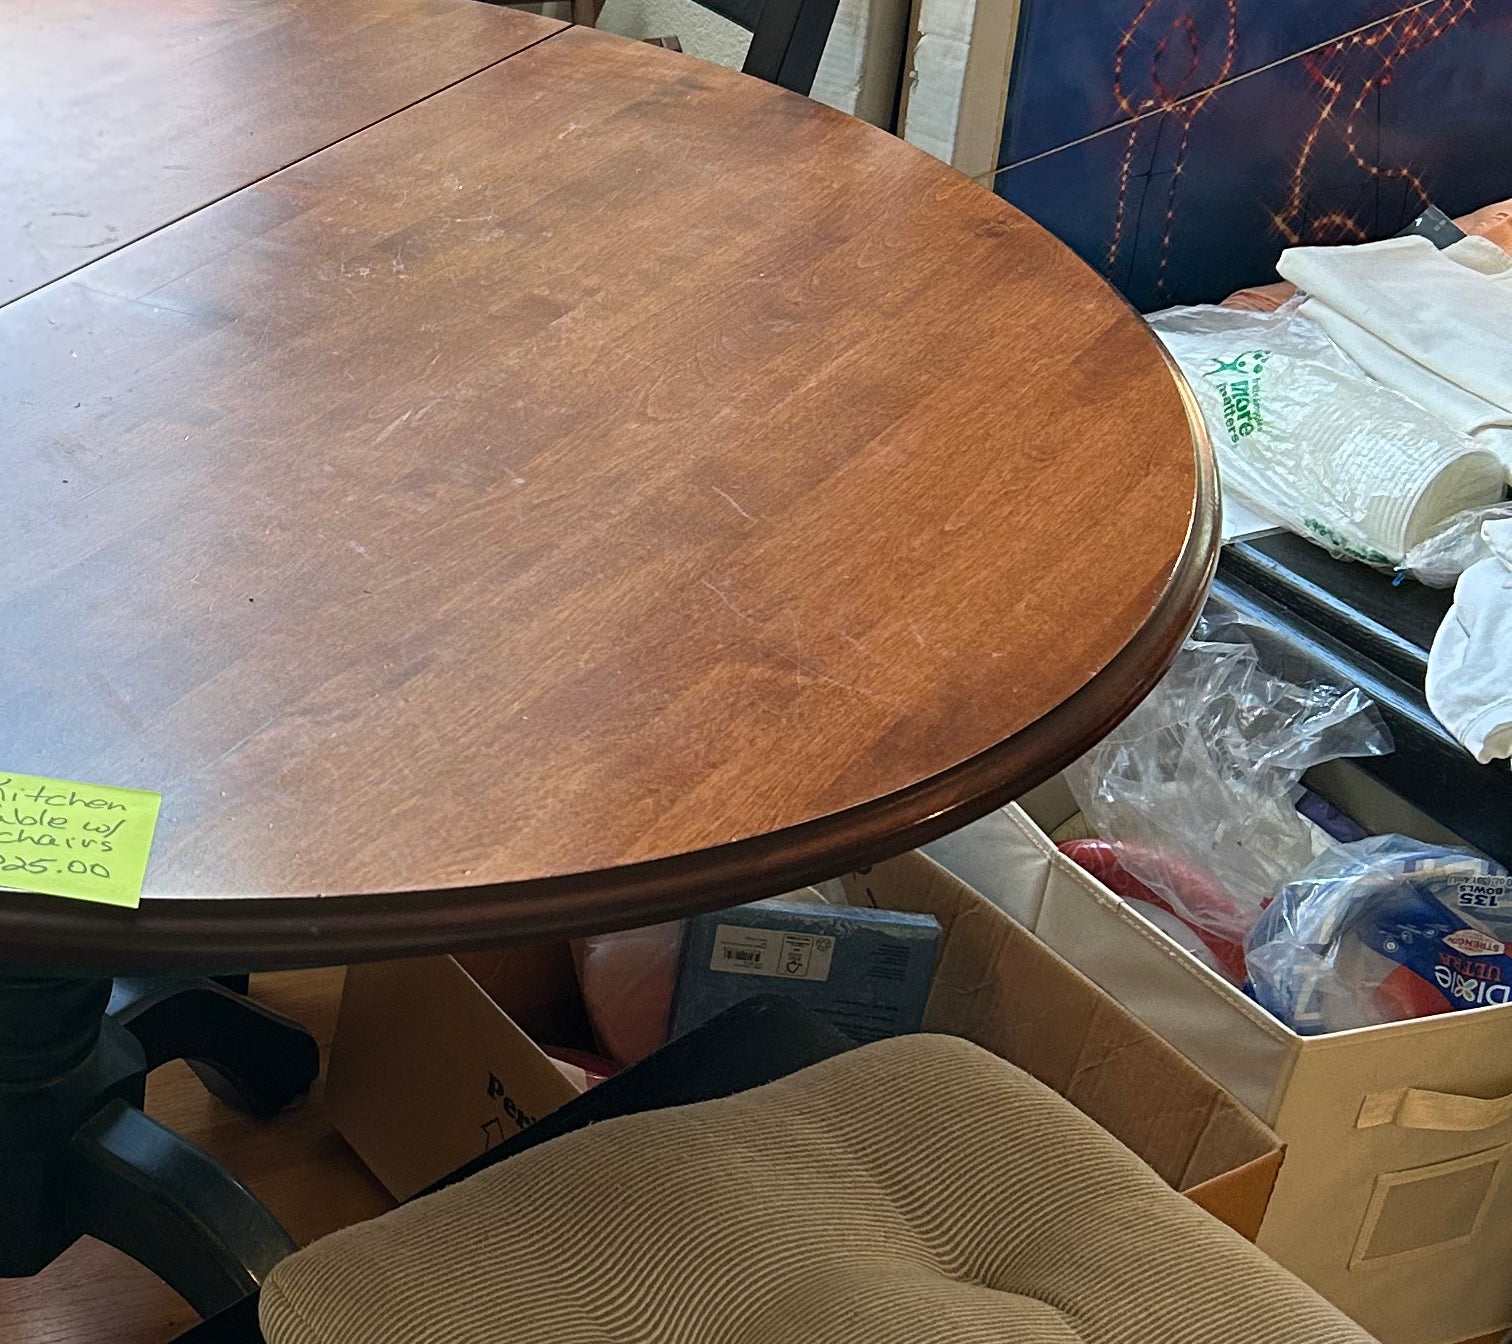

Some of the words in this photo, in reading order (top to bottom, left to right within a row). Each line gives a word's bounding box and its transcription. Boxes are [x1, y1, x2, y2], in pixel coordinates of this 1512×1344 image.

[1216, 382, 1240, 444] matters
[1230, 380, 1255, 438] more
[82, 819, 127, 837] w/
[1459, 884, 1504, 895] BOWLS
[1459, 892, 1498, 907] 135
[1438, 952, 1502, 983] ULTRA
